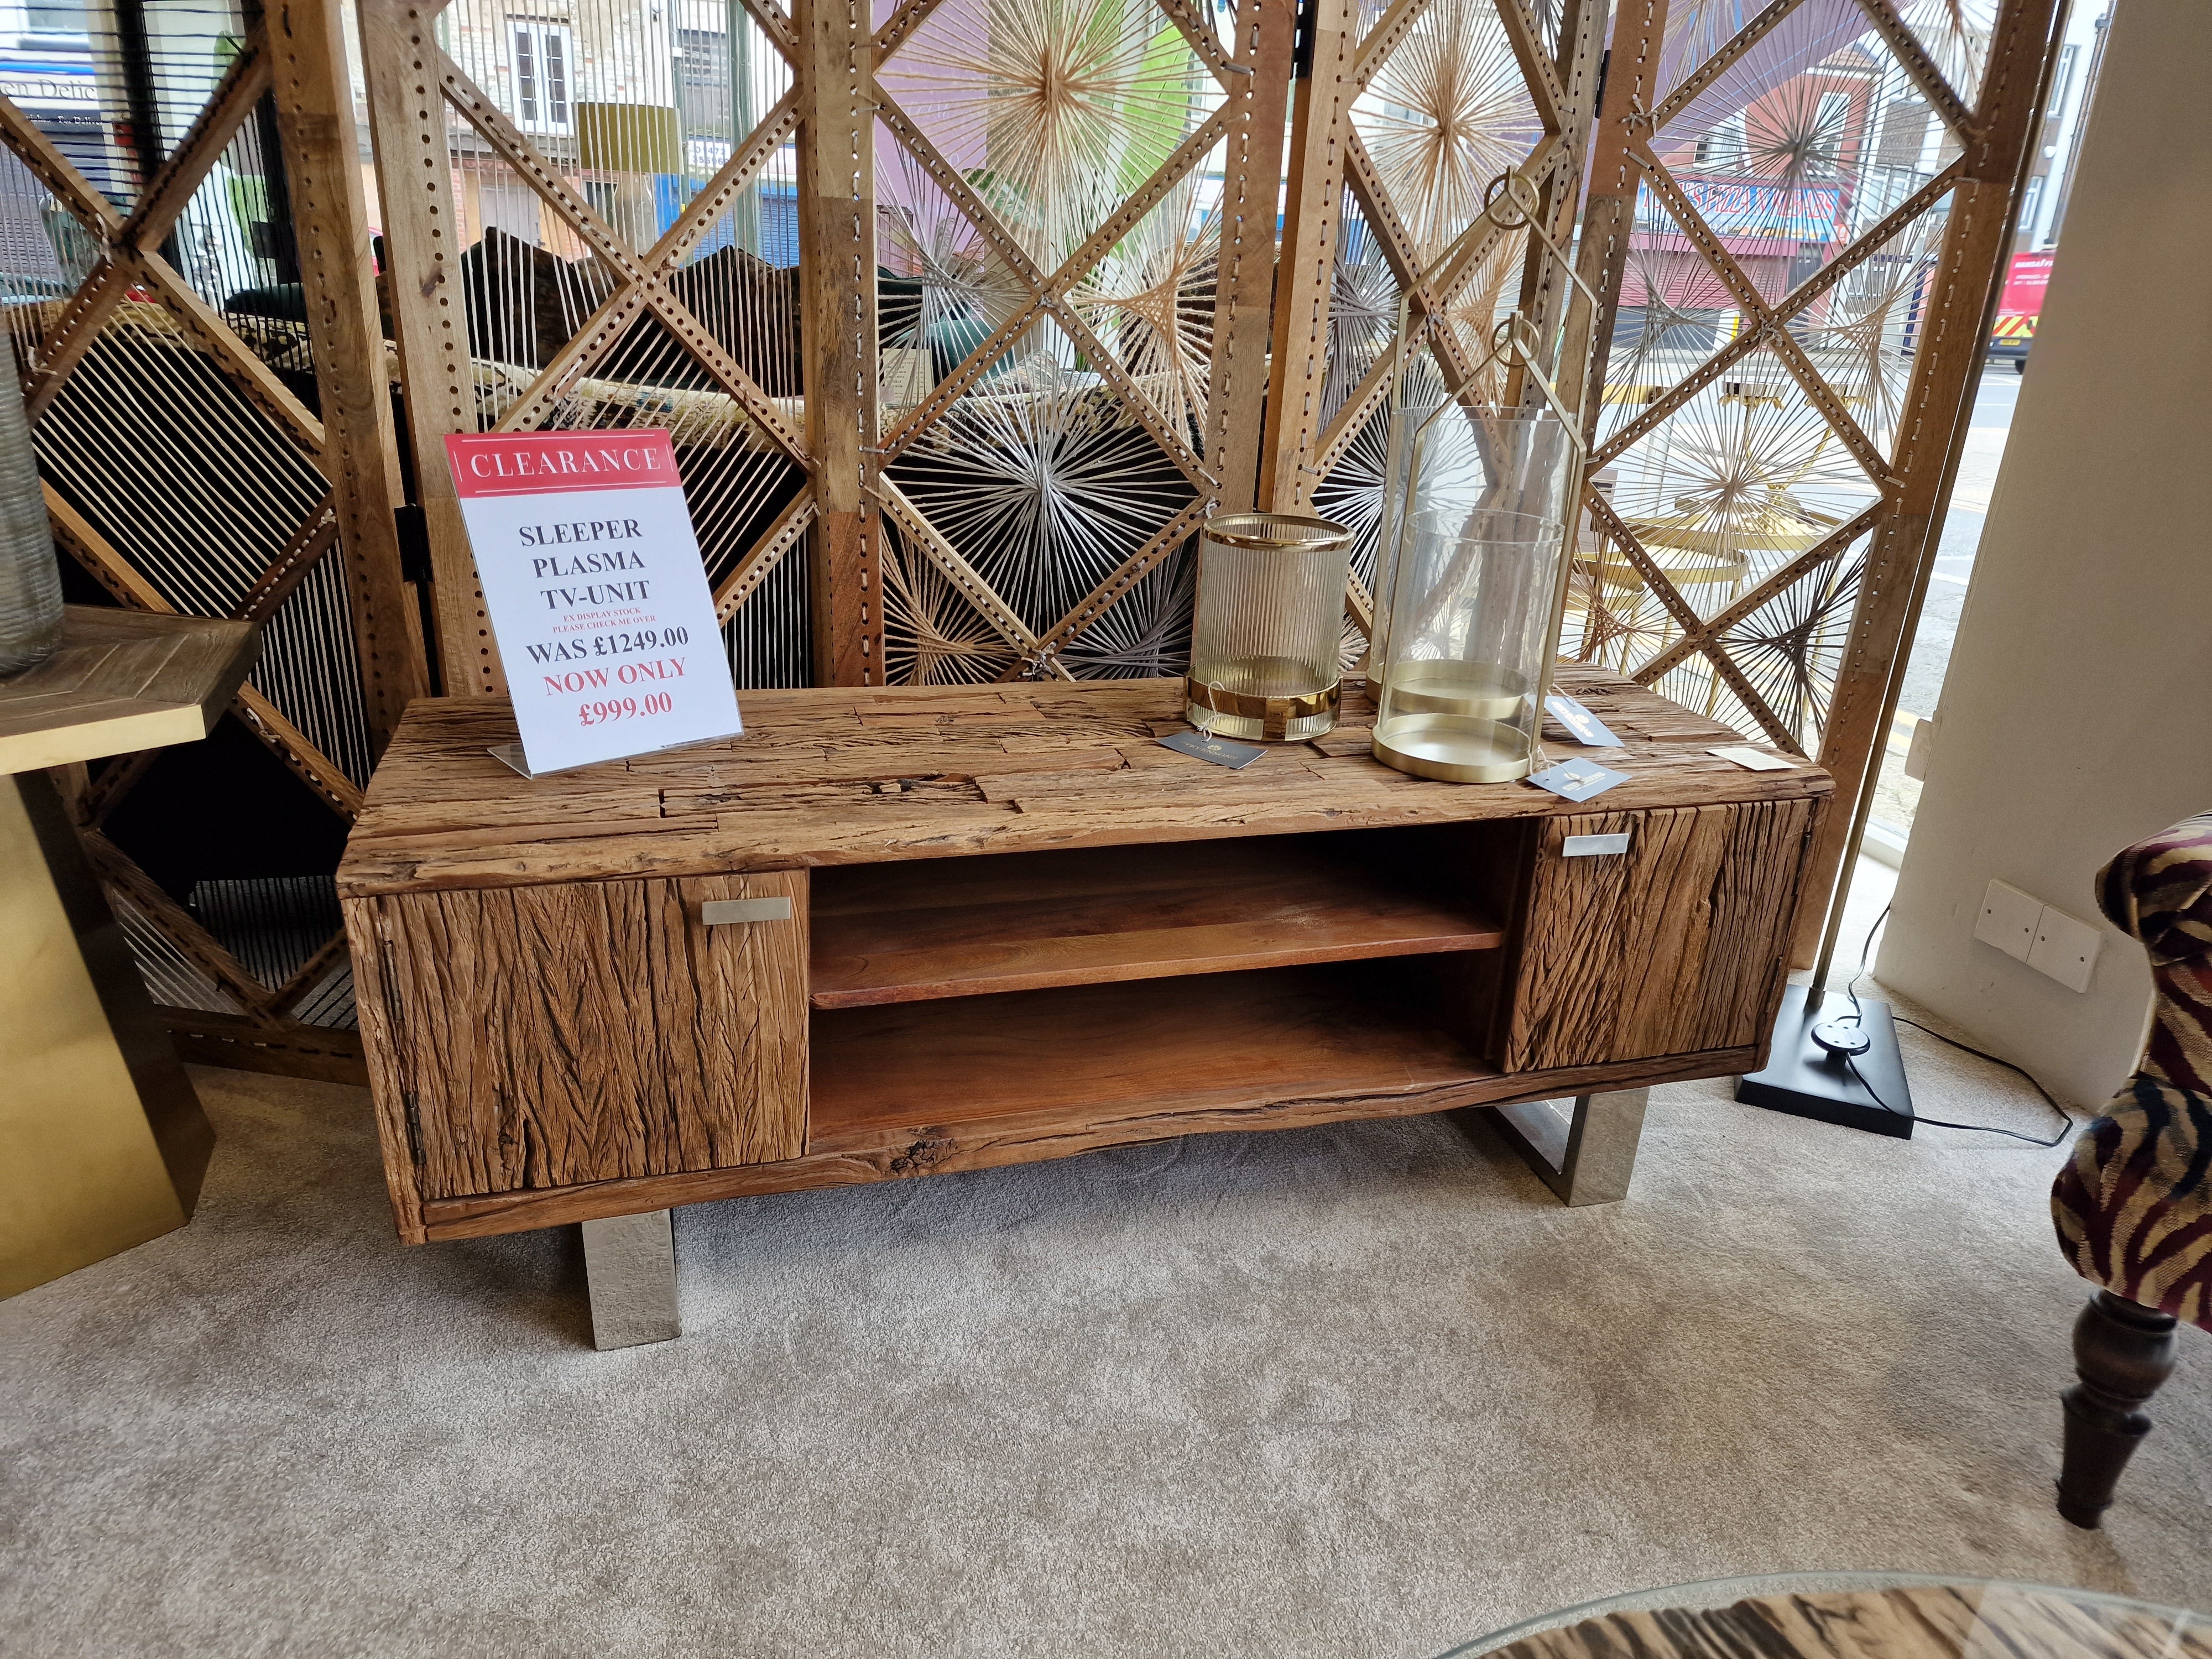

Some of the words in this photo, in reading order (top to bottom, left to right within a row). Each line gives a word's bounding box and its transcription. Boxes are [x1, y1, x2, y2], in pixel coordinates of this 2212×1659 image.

[1705, 183, 1751, 215] PIZZA
[1770, 189, 1835, 220] KEBABS
[471, 448, 661, 477] CLEARANCE
[519, 519, 644, 547] SLEEPER
[531, 550, 646, 578] PLASMA
[540, 580, 650, 609] TV-UNIT
[553, 623, 586, 634] PLEASE
[587, 619, 617, 629] CHECK
[618, 618, 632, 626] ME
[633, 614, 656, 624] OVER
[563, 614, 576, 623] EX
[577, 610, 612, 621] DISPLAY
[613, 607, 641, 617] STOCK
[525, 639, 587, 665] WAS
[593, 625, 689, 656] £1249.00
[543, 668, 609, 696] NOW
[618, 658, 686, 684] ONLY
[579, 691, 672, 727] £999.00
